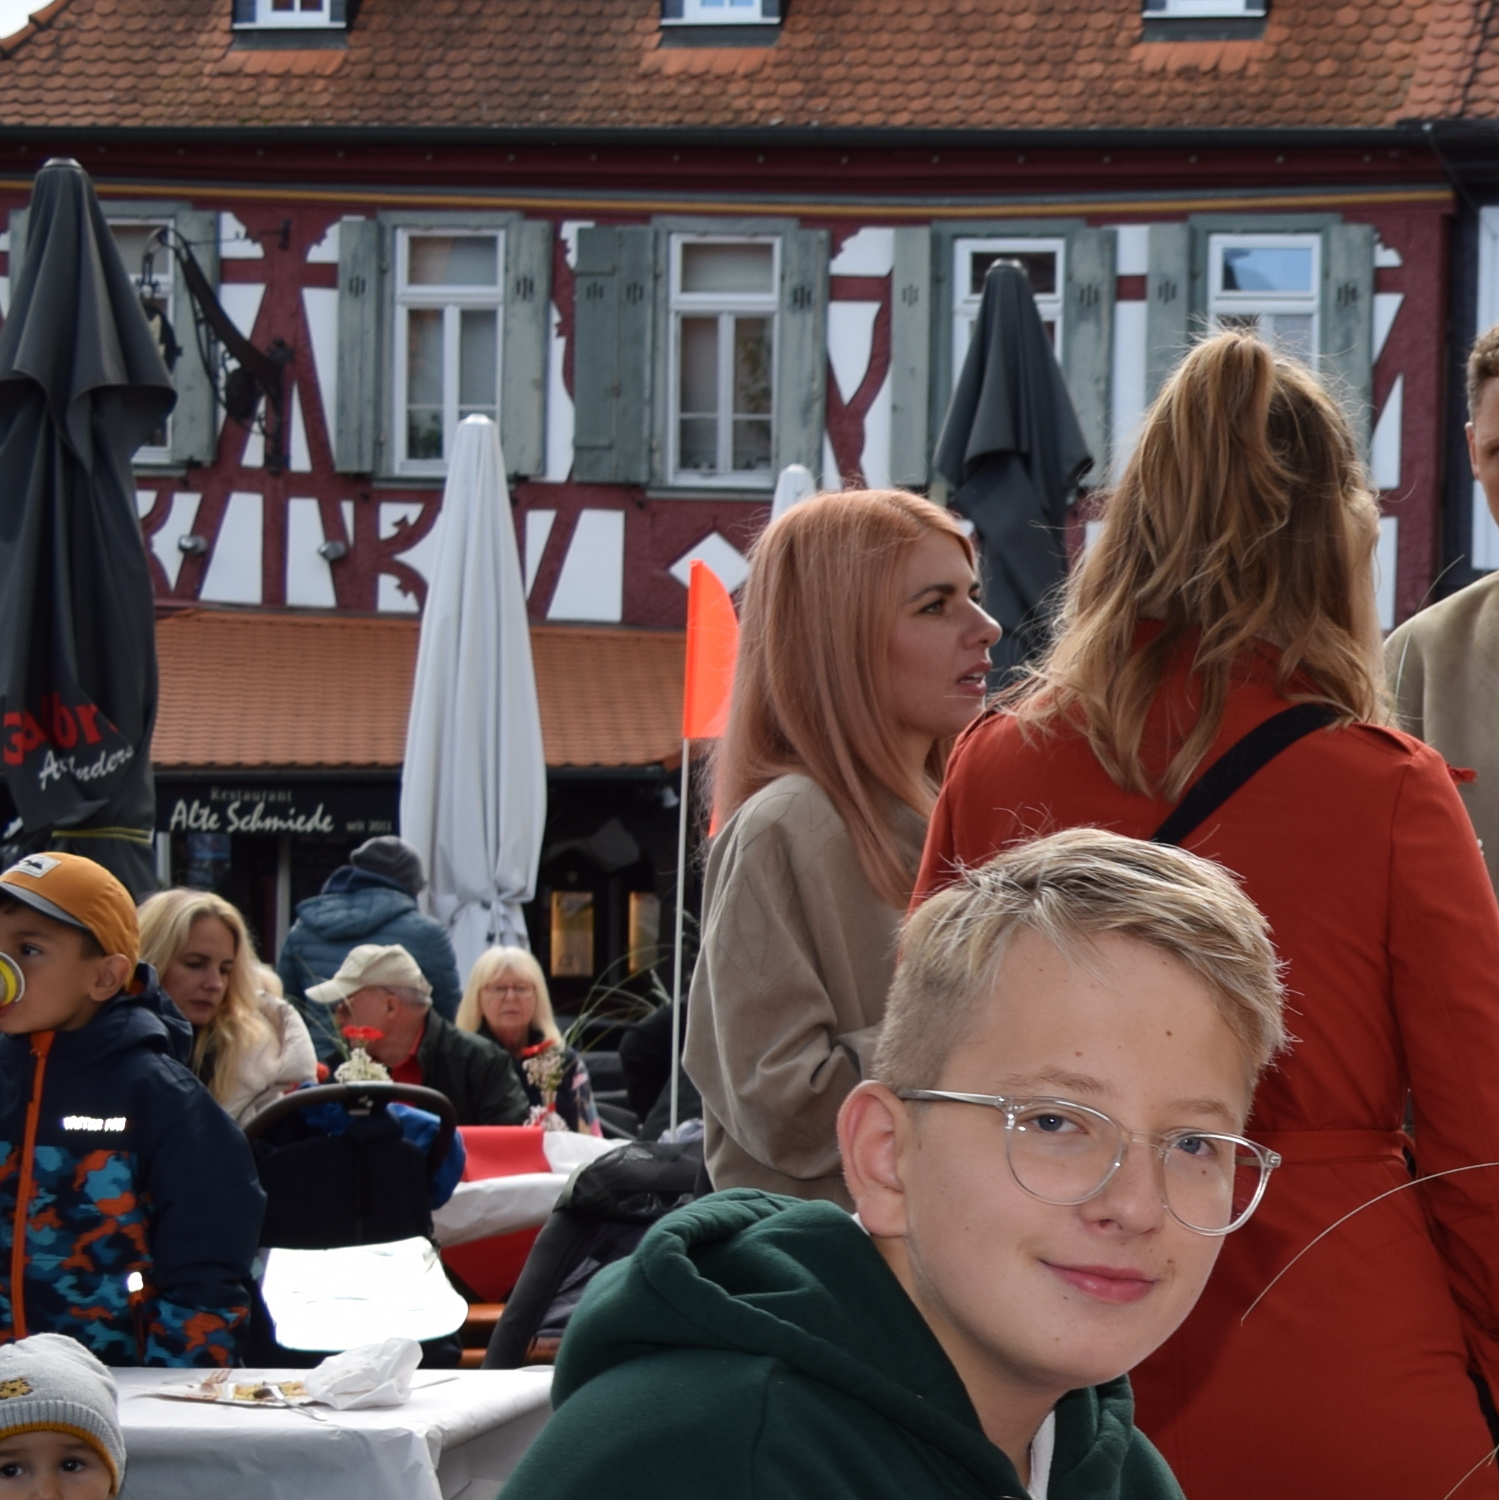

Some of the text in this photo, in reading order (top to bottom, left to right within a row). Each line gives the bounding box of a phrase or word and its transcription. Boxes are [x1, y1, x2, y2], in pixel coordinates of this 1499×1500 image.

[210, 786, 292, 803] Restaurant
[170, 799, 334, 833] Alte Schmiede
[346, 820, 366, 832] seit
